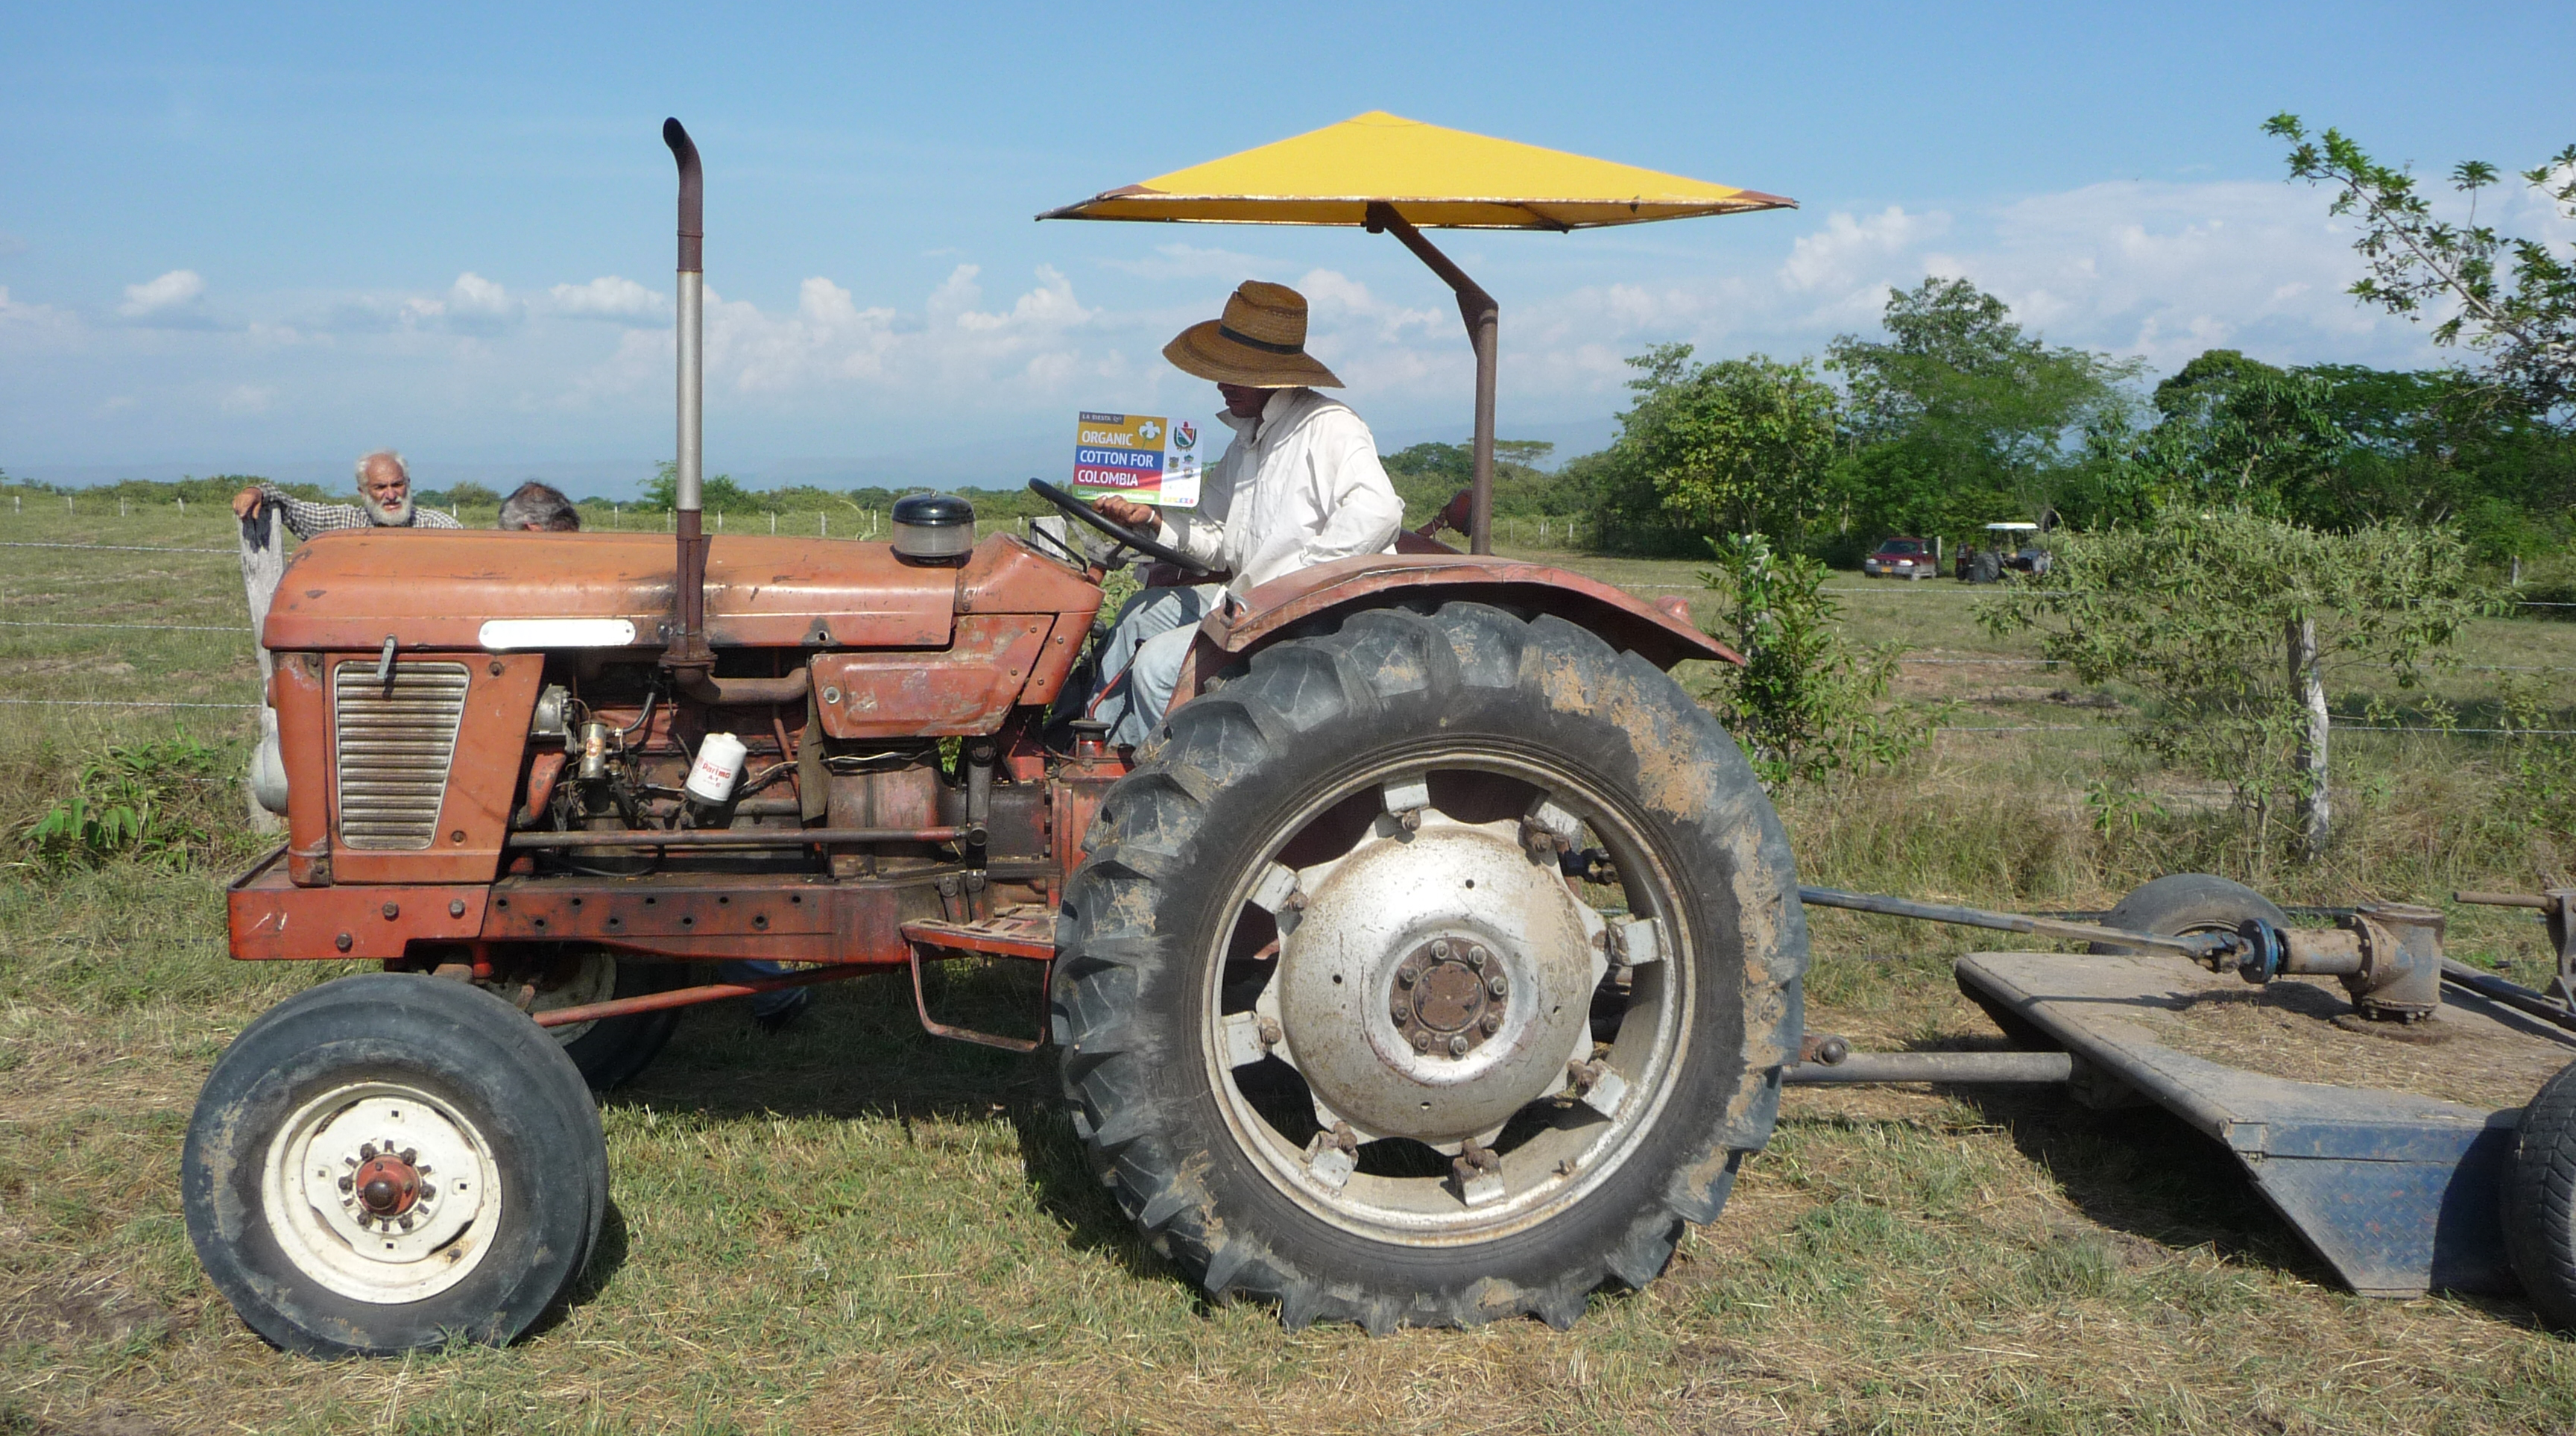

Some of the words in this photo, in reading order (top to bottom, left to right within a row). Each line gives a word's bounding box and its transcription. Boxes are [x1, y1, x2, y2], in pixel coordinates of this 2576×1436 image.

[1082, 430, 1134, 446] ORGANIC
[1080, 450, 1128, 466] COTTON
[1130, 453, 1154, 467] FOR
[1078, 470, 1139, 486] COLOMBIA
